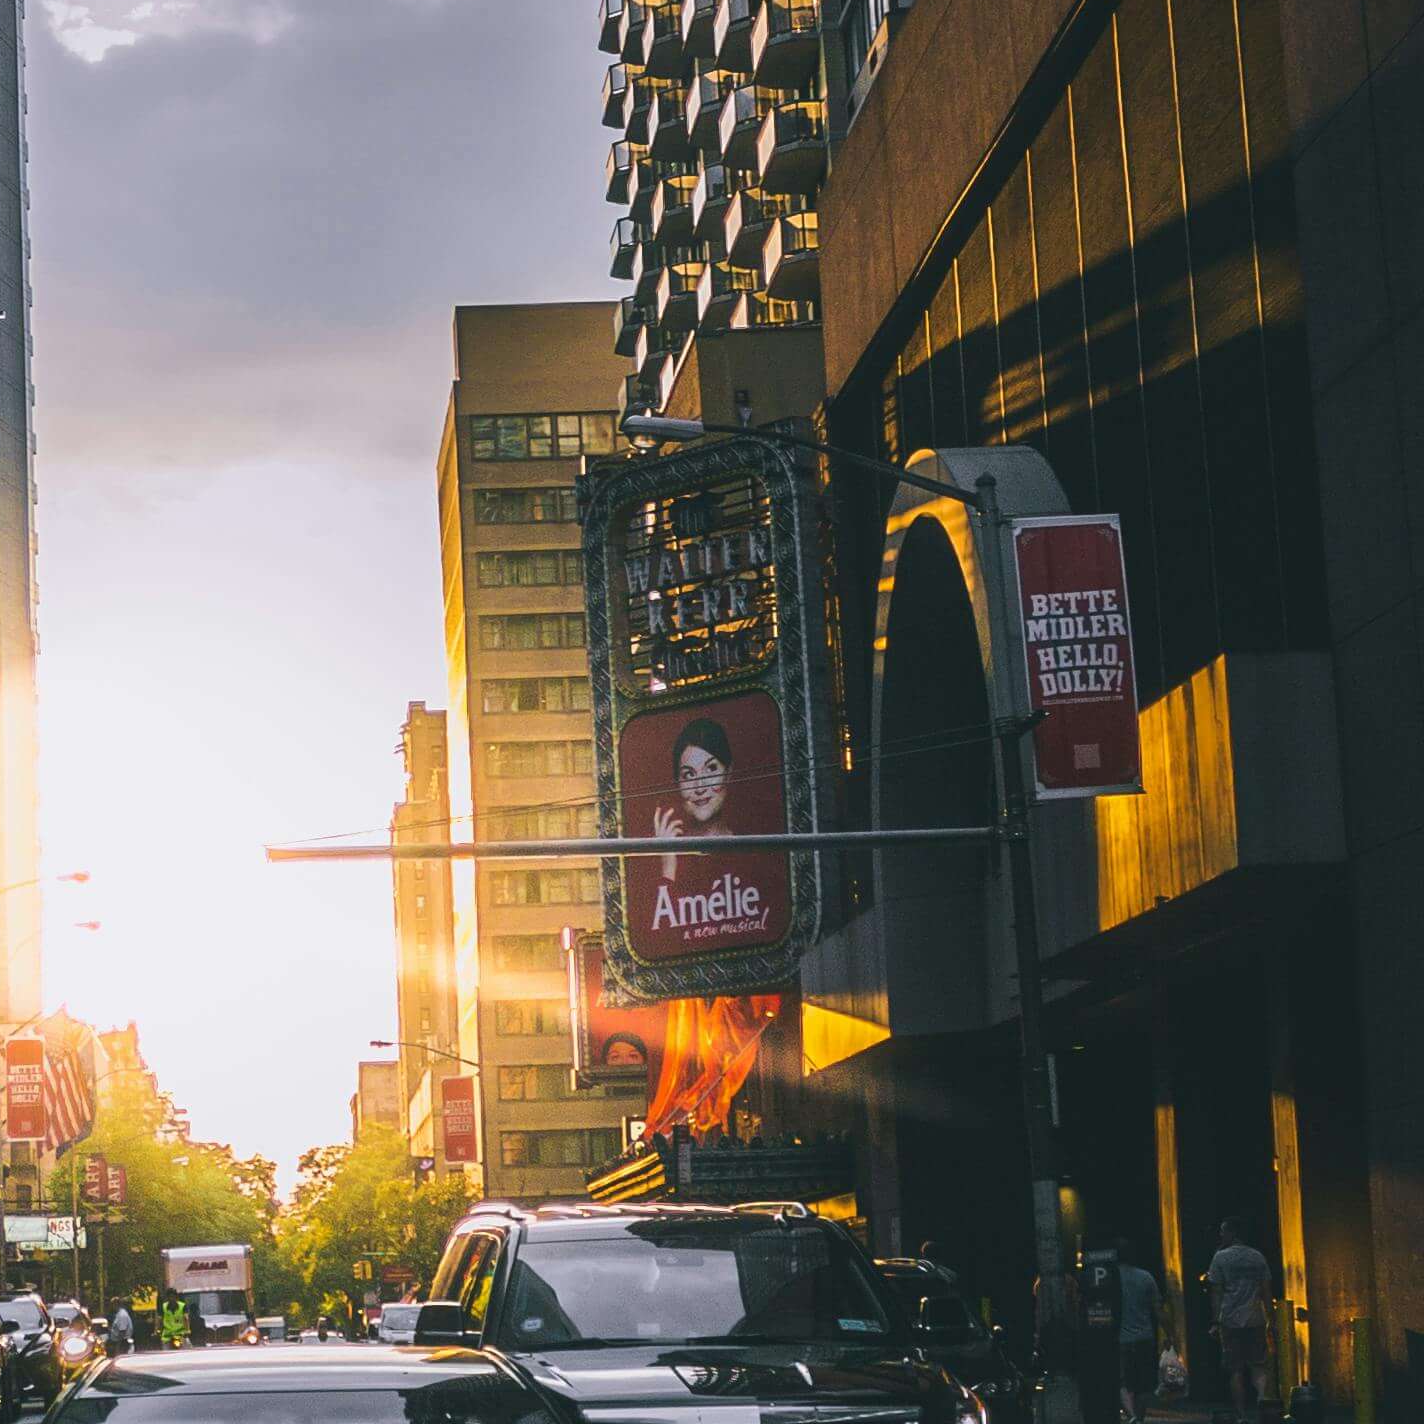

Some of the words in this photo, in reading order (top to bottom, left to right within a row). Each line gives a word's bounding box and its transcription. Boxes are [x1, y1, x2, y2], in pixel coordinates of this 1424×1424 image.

[624, 529, 769, 596] WALTER
[648, 580, 750, 634] KERR
[1030, 589, 1118, 616] BETTE
[1026, 613, 1127, 642] MIDLER
[1037, 643, 1125, 671] HELLO,
[1038, 669, 1124, 697] DOLLY!
[651, 873, 761, 930] Amélie
[1094, 1267, 1107, 1286] P
